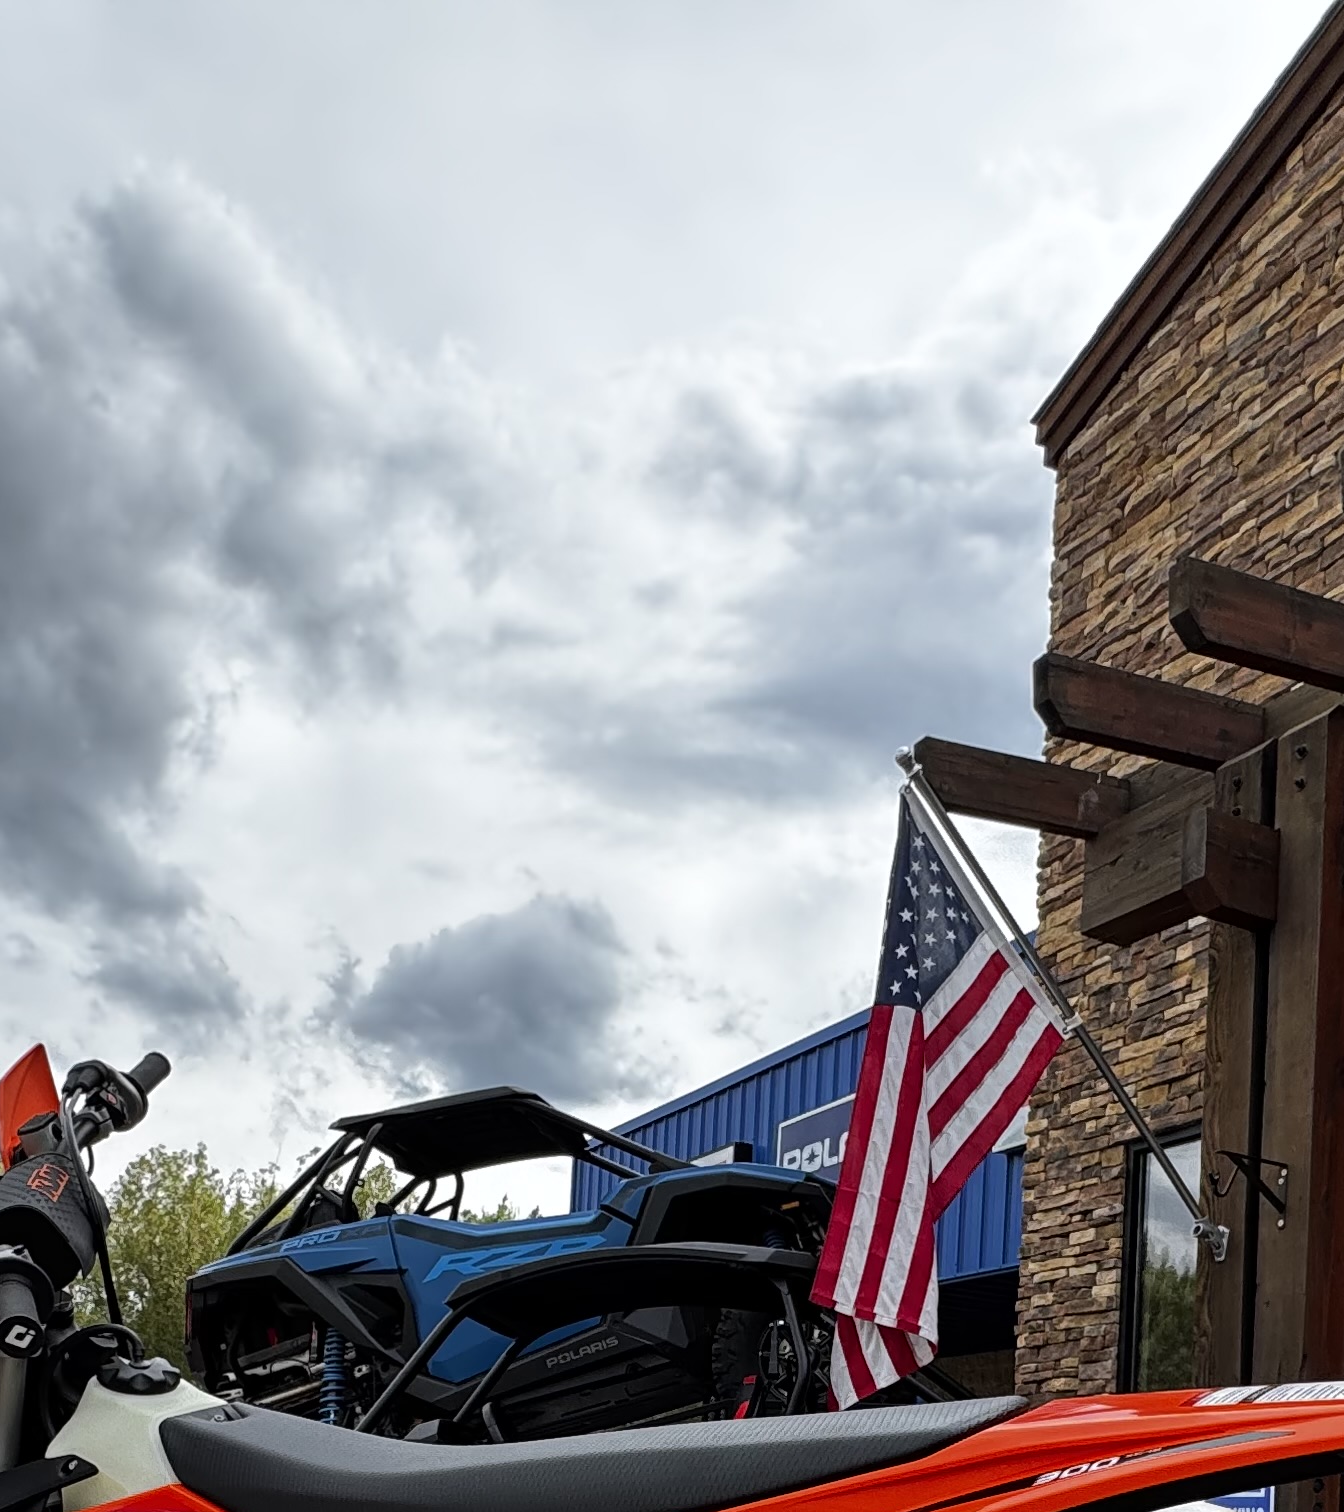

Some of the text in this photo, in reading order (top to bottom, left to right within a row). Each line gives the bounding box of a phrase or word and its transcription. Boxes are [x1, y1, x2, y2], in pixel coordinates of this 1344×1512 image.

[279, 1230, 342, 1253] PRO
[545, 1335, 619, 1369] POLARIS
[1031, 1456, 1121, 1487] 300
